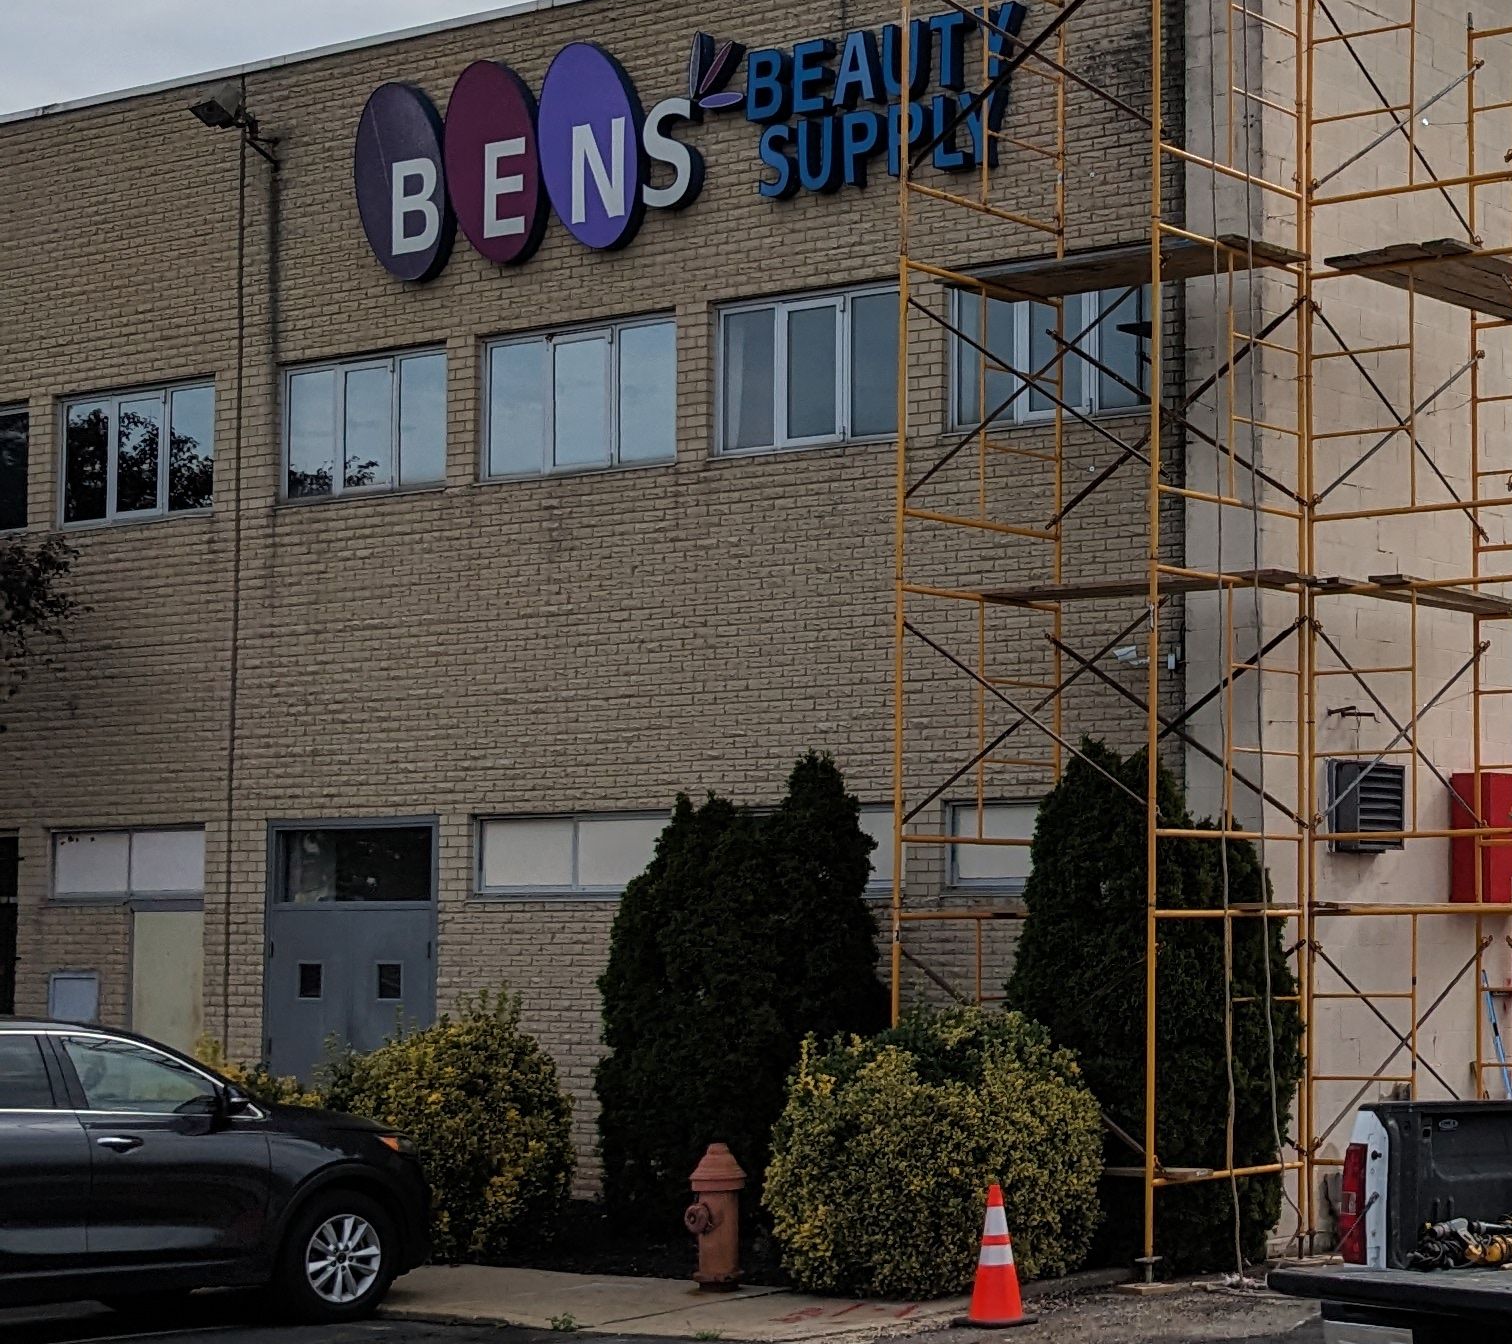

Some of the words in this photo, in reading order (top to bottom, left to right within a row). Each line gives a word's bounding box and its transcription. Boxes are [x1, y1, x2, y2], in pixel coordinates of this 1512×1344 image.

[745, 2, 1022, 123] BEAUTY
[391, 98, 698, 256] BENS
[758, 87, 1006, 199] SUPPLY
